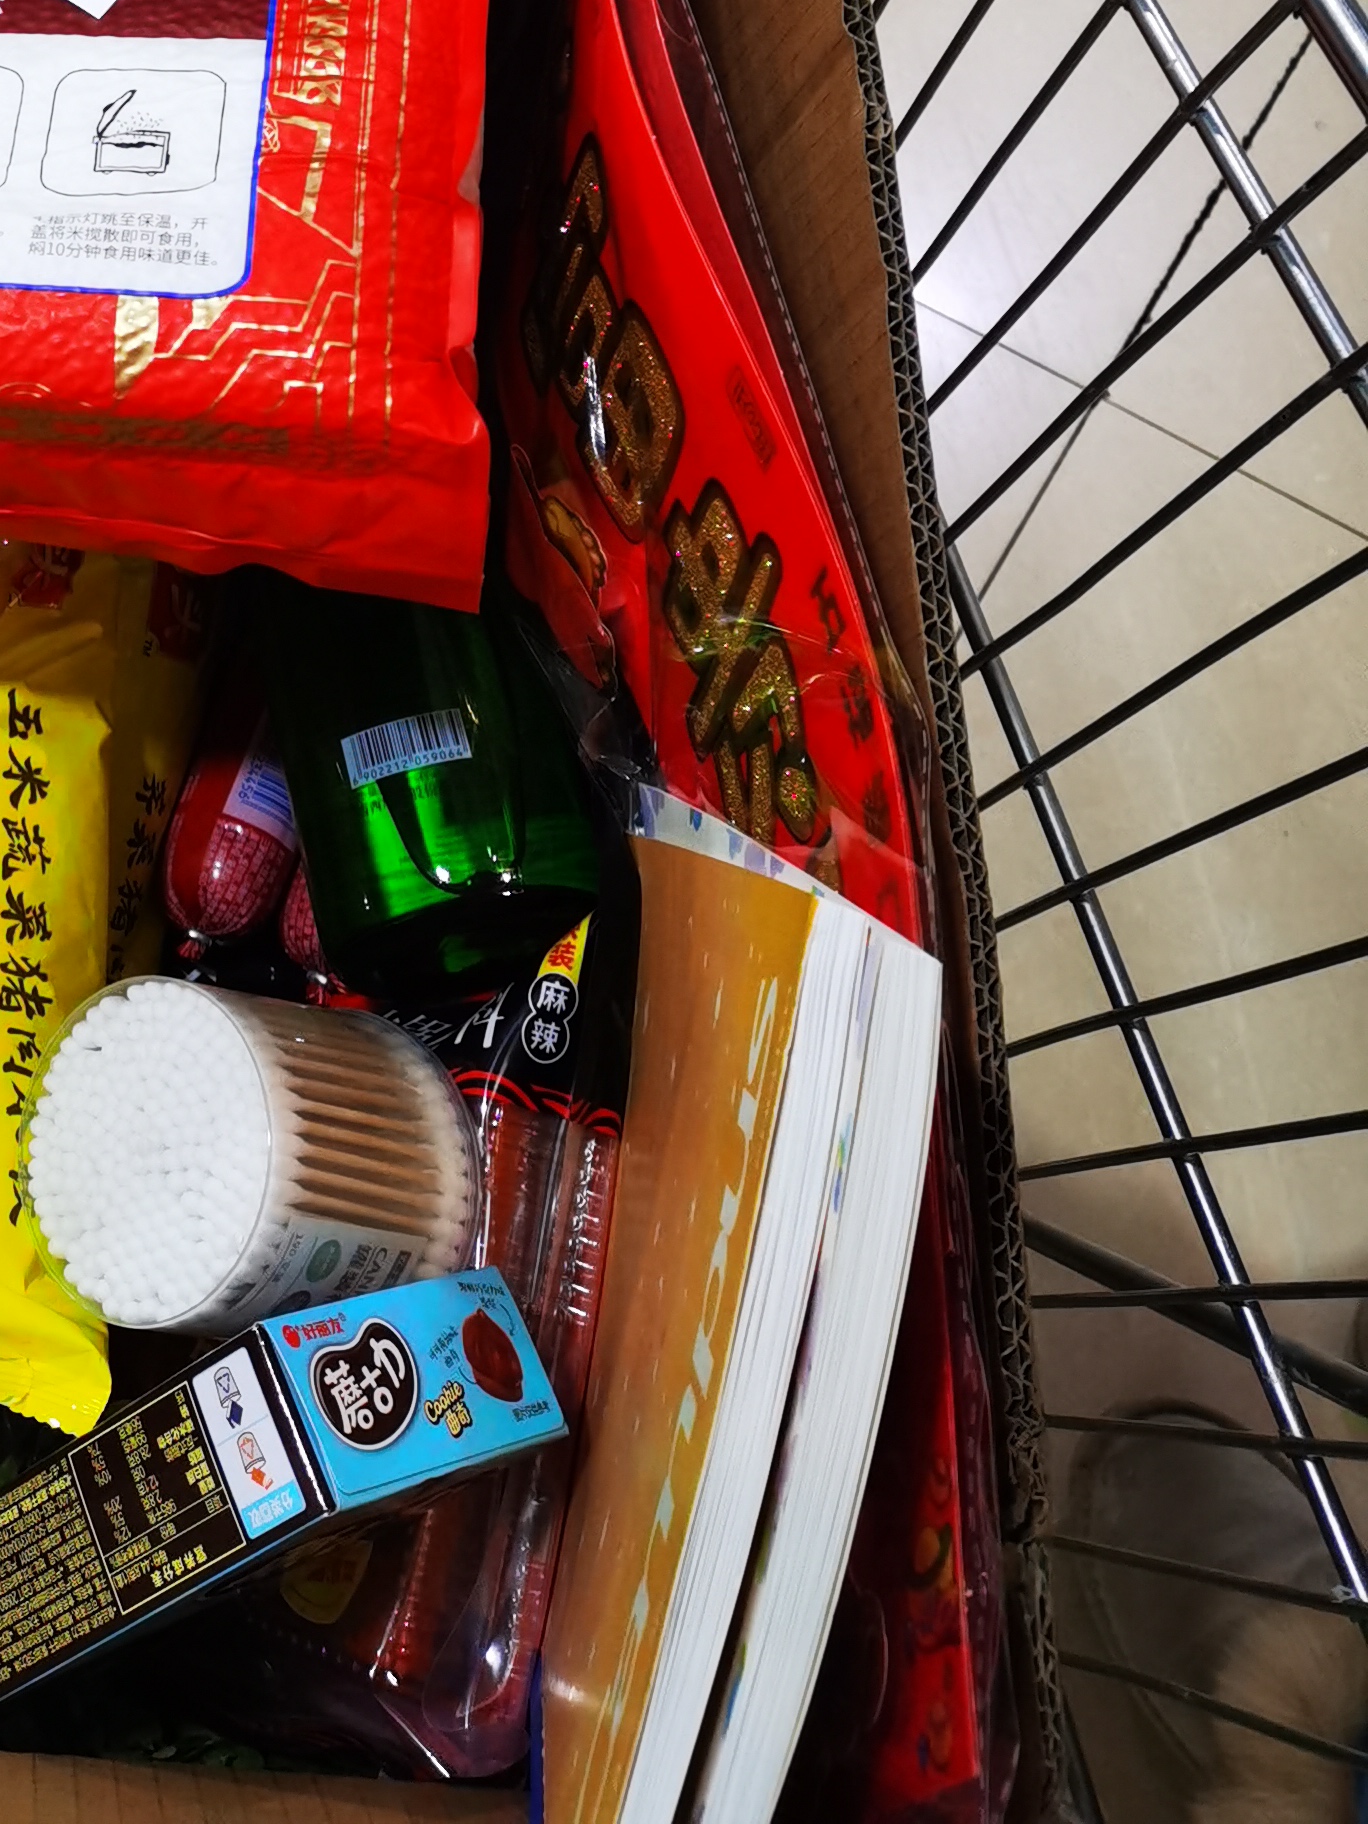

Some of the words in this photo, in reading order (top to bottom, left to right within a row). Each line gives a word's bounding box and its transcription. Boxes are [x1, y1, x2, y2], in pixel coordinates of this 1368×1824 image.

[363, 759, 409, 781] 902212
[414, 748, 463, 766] 059064
[530, 980, 571, 1055] 麻辣
[422, 1380, 464, 1424] Cookie
[445, 1399, 473, 1437] 曲奇
[92, 1467, 113, 1487] 10%
[101, 1494, 124, 1515] 20%
[149, 1543, 208, 1588] 营养成分表
